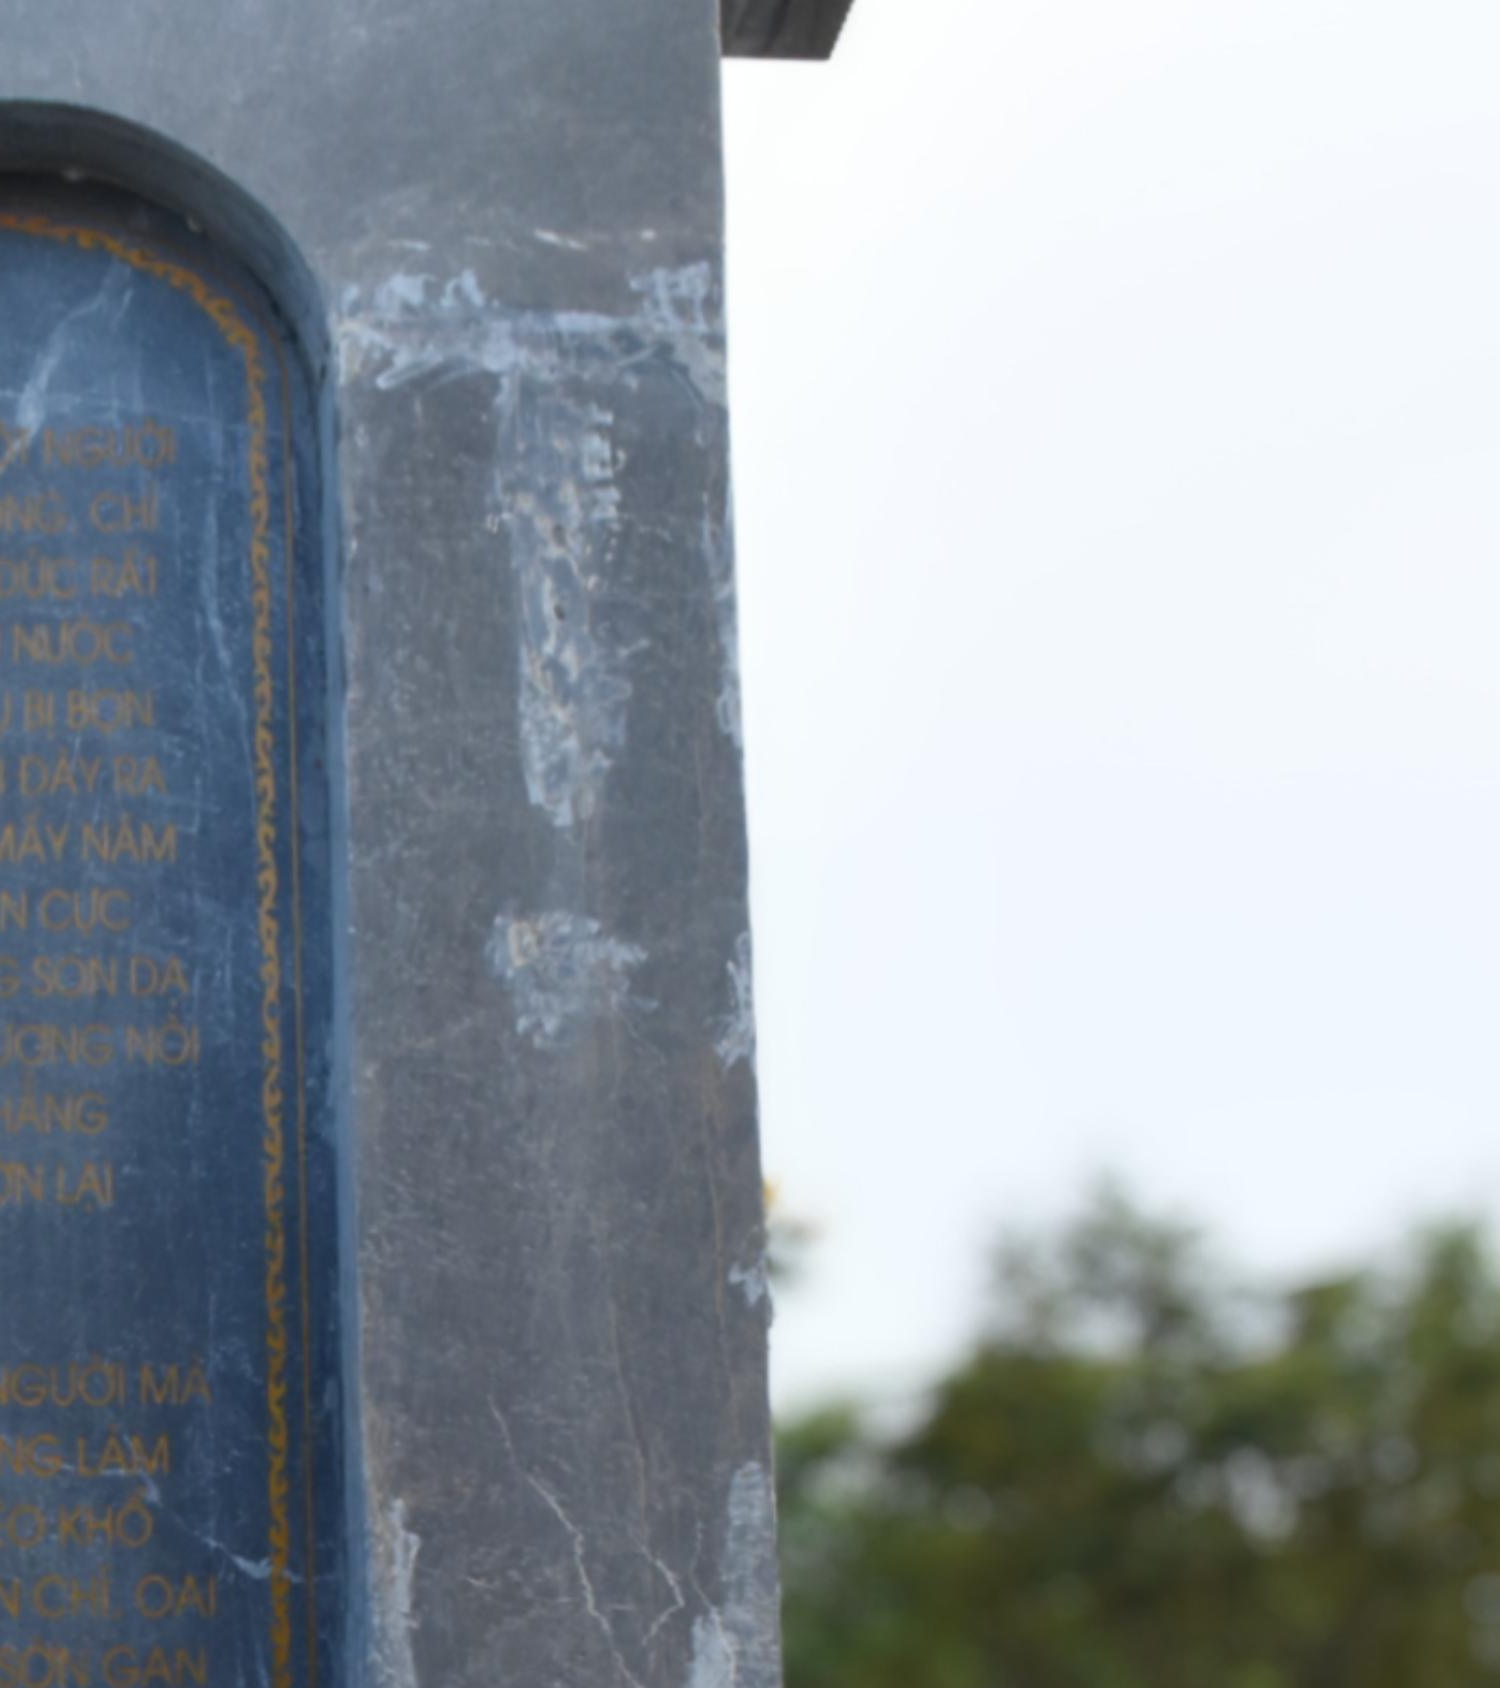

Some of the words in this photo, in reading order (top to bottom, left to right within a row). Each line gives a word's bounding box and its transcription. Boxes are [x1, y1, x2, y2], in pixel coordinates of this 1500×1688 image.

[91, 482, 157, 535] CHÍ
[92, 546, 158, 597] RẤT
[14, 616, 133, 665] NƯỚC
[26, 691, 53, 734] BỊ
[68, 689, 155, 735] BỌN
[19, 748, 100, 795] ĐÀY
[114, 754, 167, 796] RA
[82, 813, 178, 863] NĂM
[42, 888, 130, 937] CỰC
[35, 956, 117, 997] SON
[130, 954, 190, 1006] DẠ
[56, 1160, 115, 1213] LẠI
[139, 1354, 212, 1404] MÀ
[78, 1425, 172, 1478] LÀM
[136, 1573, 217, 1619] OAI
